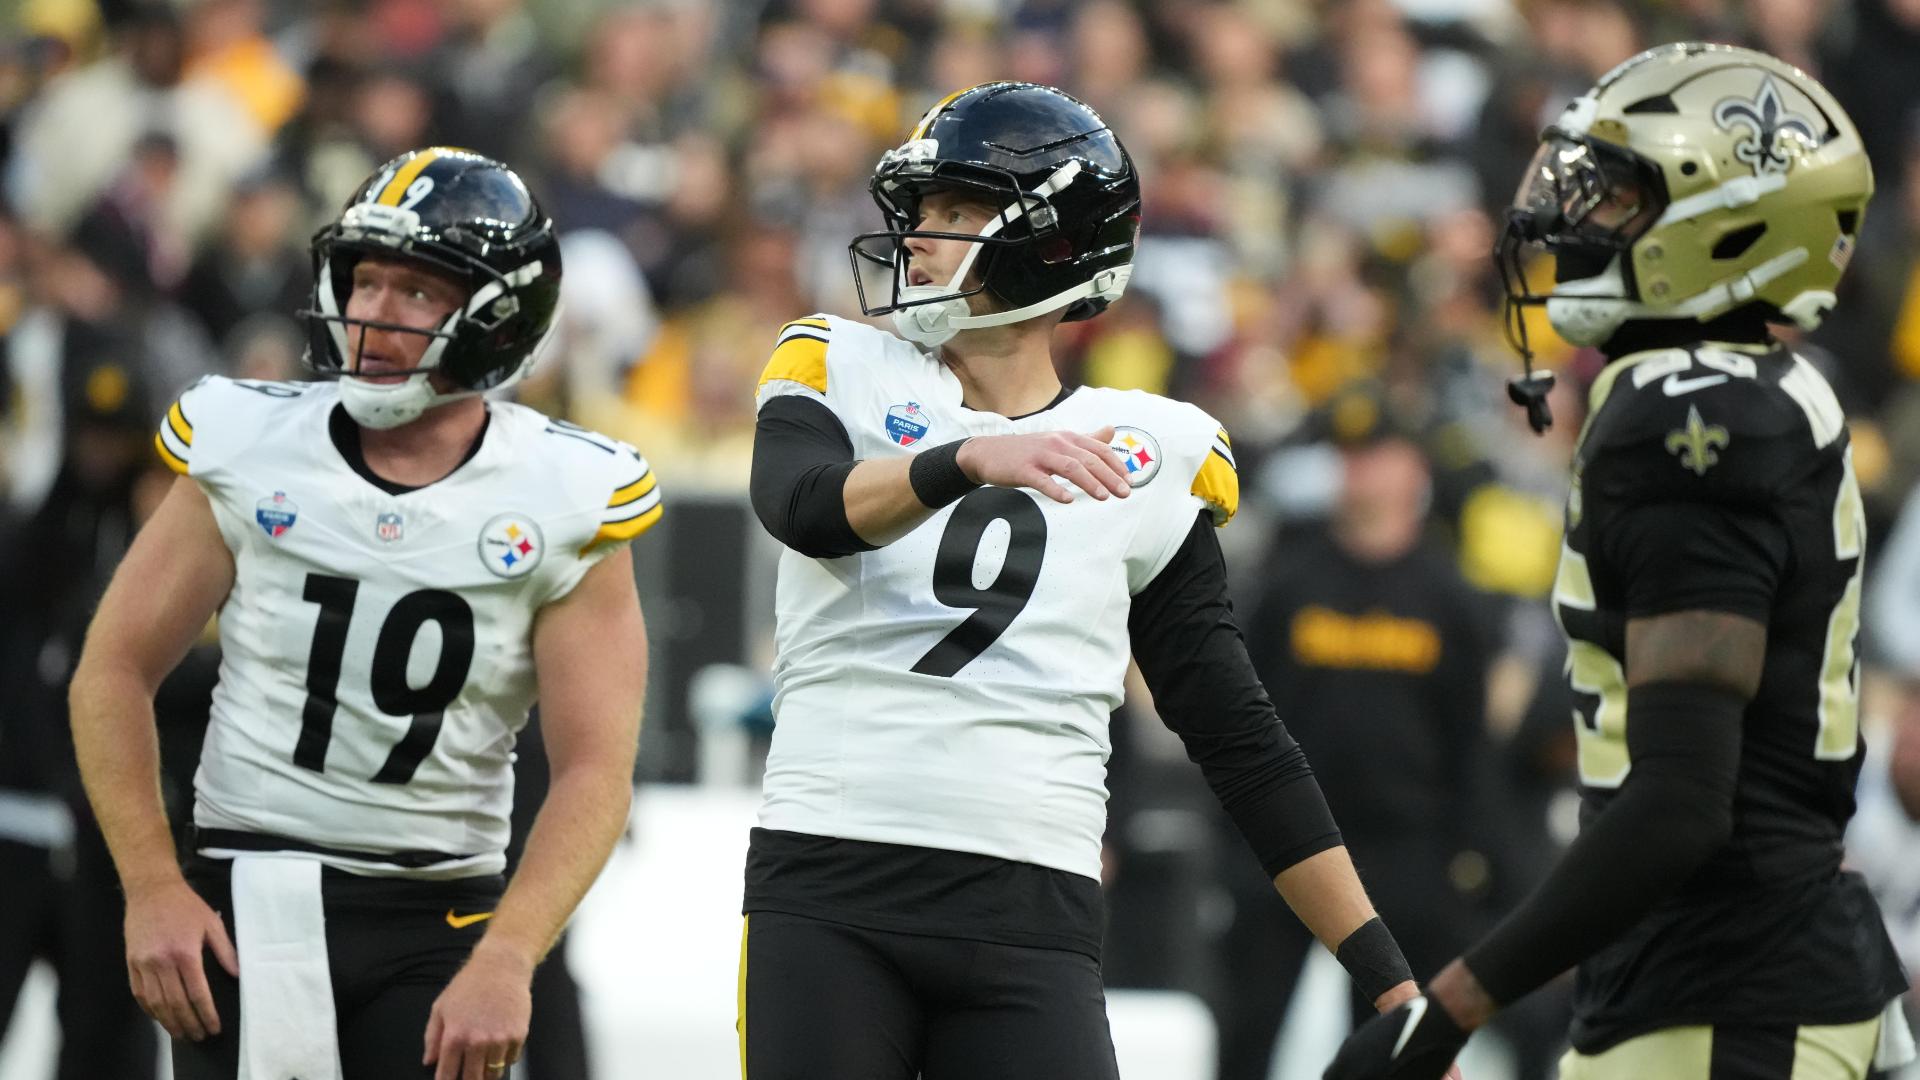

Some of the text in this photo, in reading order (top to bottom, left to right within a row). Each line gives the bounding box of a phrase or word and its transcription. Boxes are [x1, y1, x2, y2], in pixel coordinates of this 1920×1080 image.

[893, 419, 920, 432] PARIS
[908, 486, 1048, 678] 9
[293, 573, 475, 785] 19
